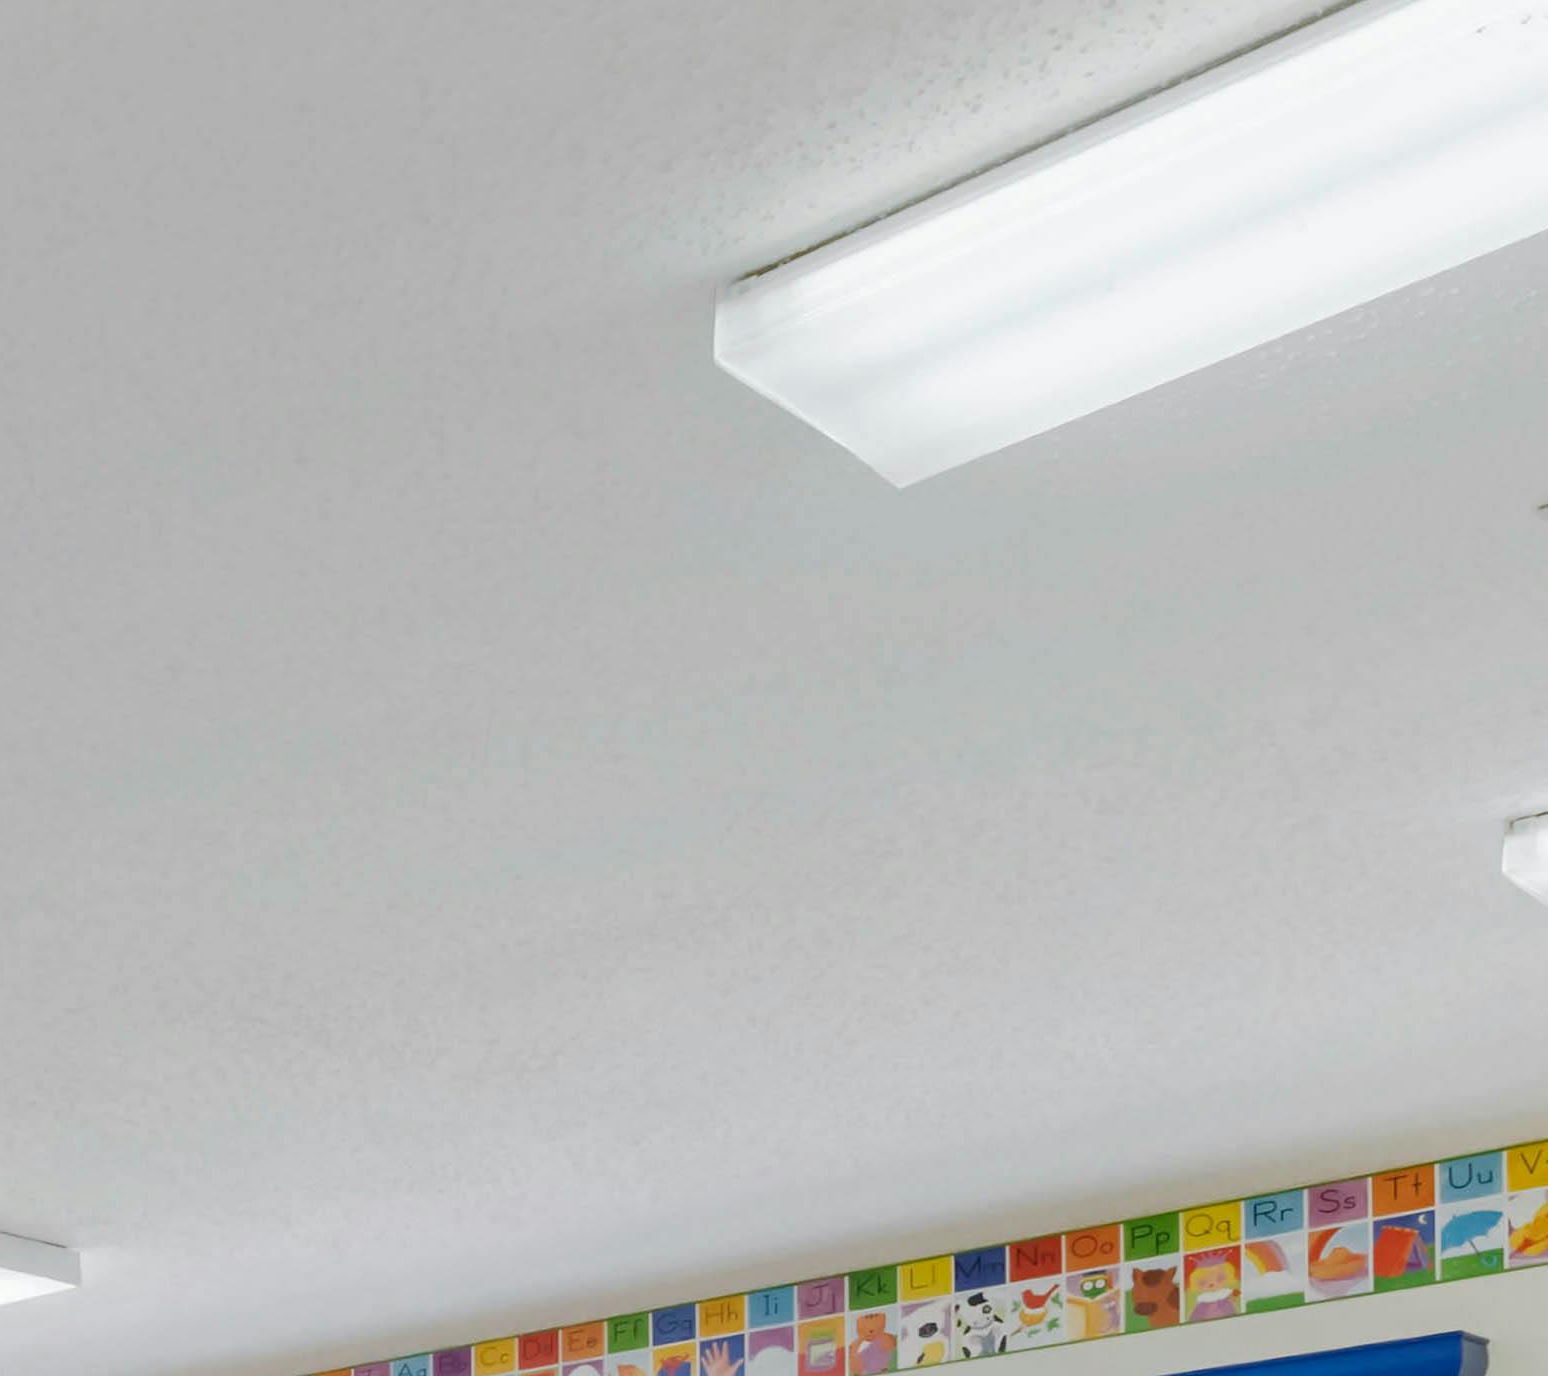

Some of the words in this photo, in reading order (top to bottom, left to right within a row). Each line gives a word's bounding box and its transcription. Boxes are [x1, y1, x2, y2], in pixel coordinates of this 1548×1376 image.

[612, 1318, 642, 1342] Ff
[855, 1274, 889, 1298] Kk
[1015, 1246, 1055, 1269] Nn
[1070, 1234, 1115, 1258] Oo
[1130, 1223, 1171, 1256] Pp
[1185, 1212, 1240, 1242] Qq
[1252, 1200, 1295, 1227] Rr
[1317, 1188, 1357, 1214] Ss
[1384, 1174, 1423, 1201] Tt
[1447, 1161, 1494, 1190] Uu
